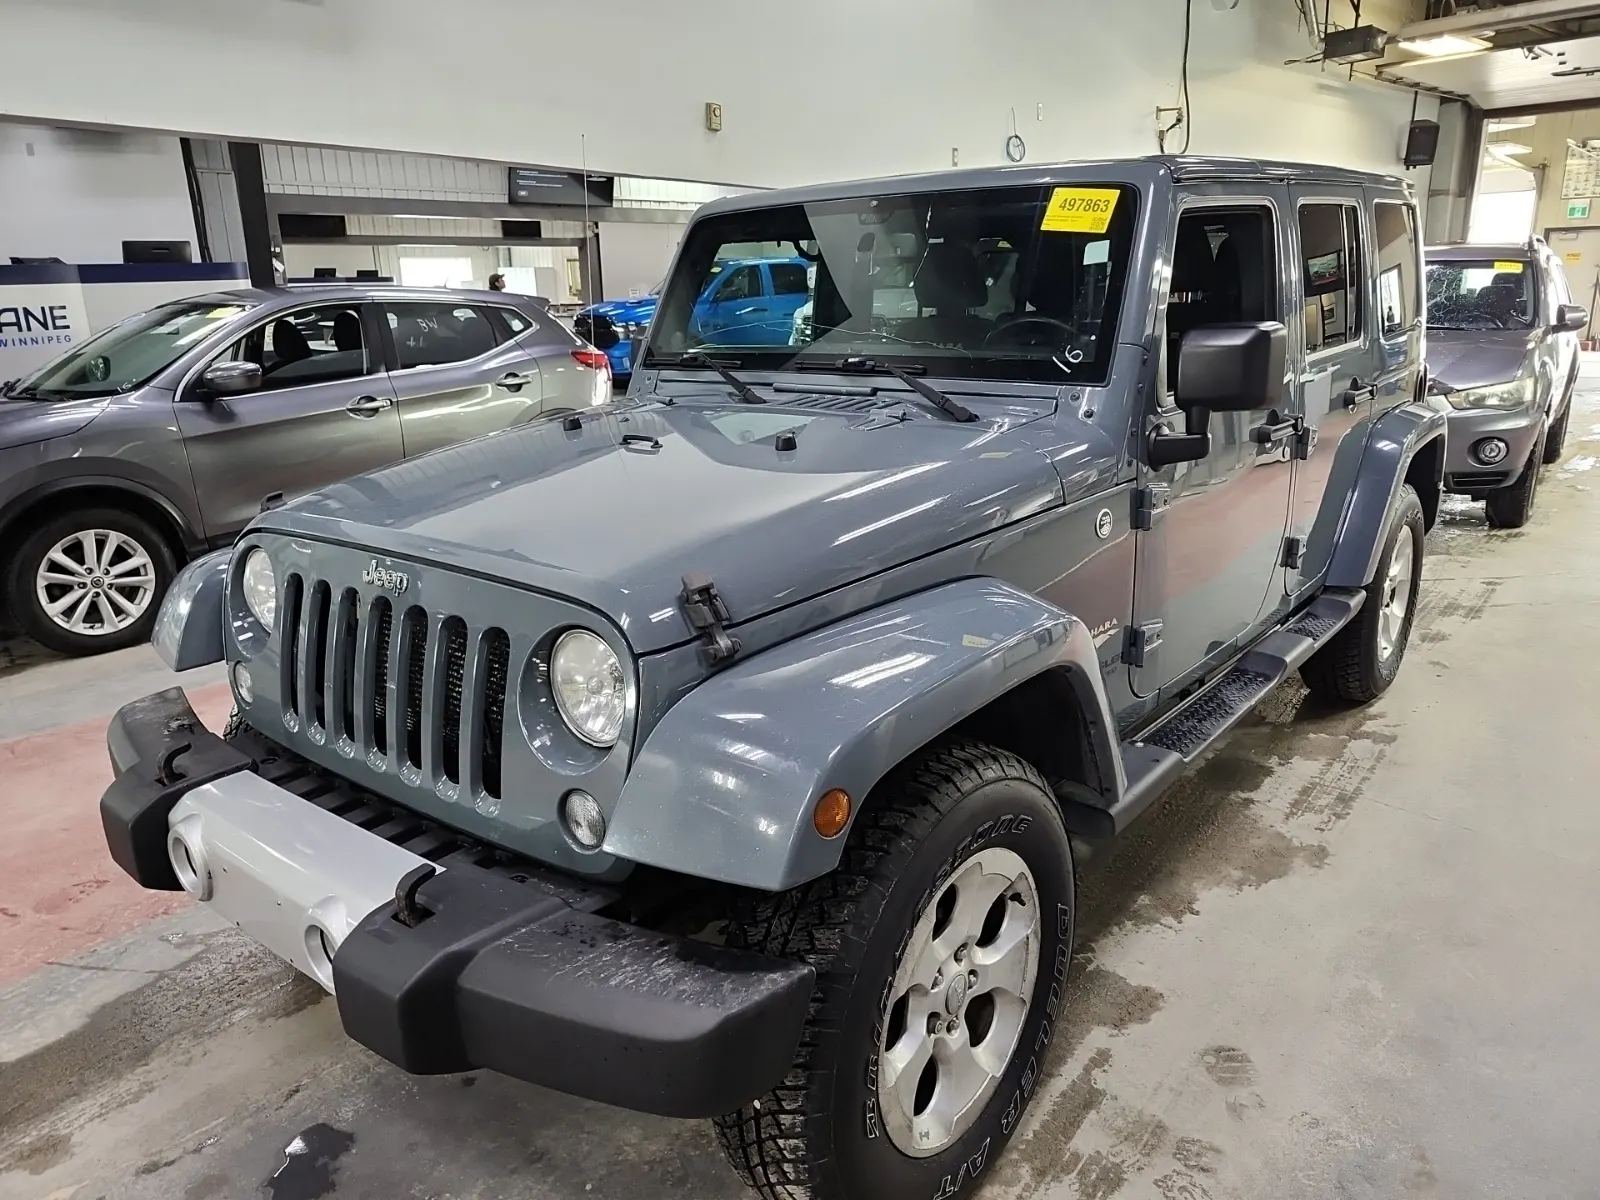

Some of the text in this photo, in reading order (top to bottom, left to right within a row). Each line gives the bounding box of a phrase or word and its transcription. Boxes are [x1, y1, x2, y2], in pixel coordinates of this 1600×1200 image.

[1058, 197, 1110, 213] 497863
[1052, 344, 1083, 374] 16
[362, 559, 409, 597] Jeep
[1090, 617, 1118, 637] HARA
[1001, 903, 1070, 1135] DUELER
[932, 1136, 992, 1200] A/T
